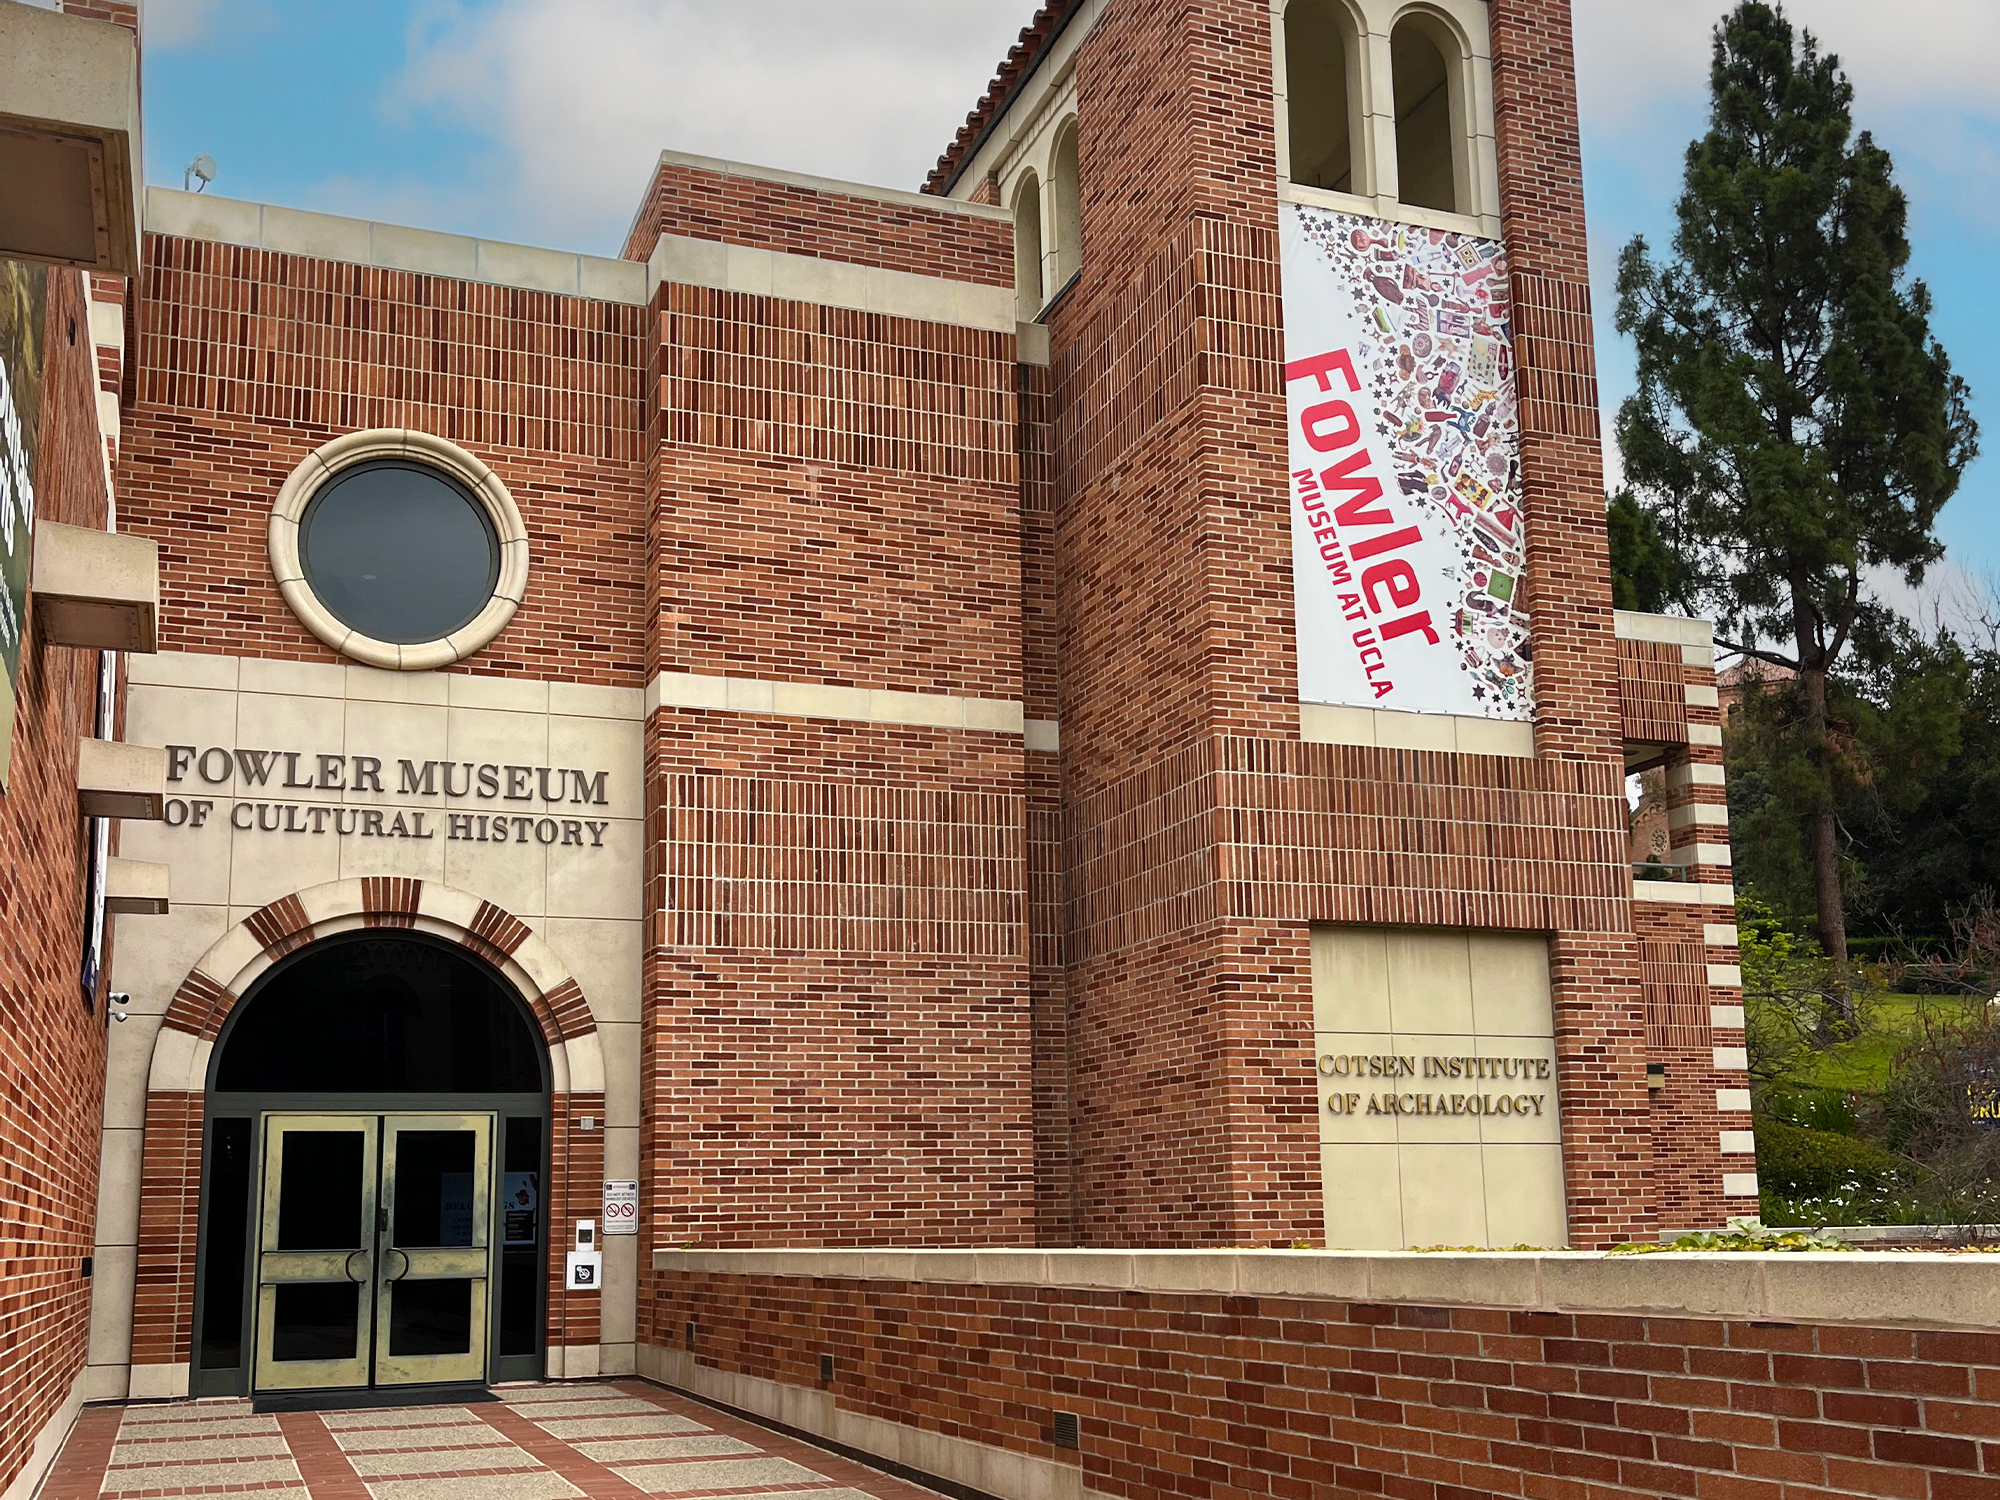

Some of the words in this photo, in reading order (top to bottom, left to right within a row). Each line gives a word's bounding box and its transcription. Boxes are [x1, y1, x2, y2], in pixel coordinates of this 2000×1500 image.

[1285, 347, 1441, 646] Fowler
[1291, 467, 1353, 587] MUSEUM
[1336, 592, 1368, 622] AT
[1352, 627, 1395, 700] UCLA
[164, 744, 385, 793] FOWLER
[397, 759, 610, 805] MUSEUM
[163, 798, 214, 828] OF
[231, 802, 434, 839] CULTURAL
[447, 813, 609, 847] HISTORY
[1318, 1054, 1416, 1078] COTSEN
[1422, 1056, 1551, 1080] INSTITUTE
[1328, 1092, 1361, 1116] OF
[1365, 1093, 1546, 1117] ARCHAEOLOGY
